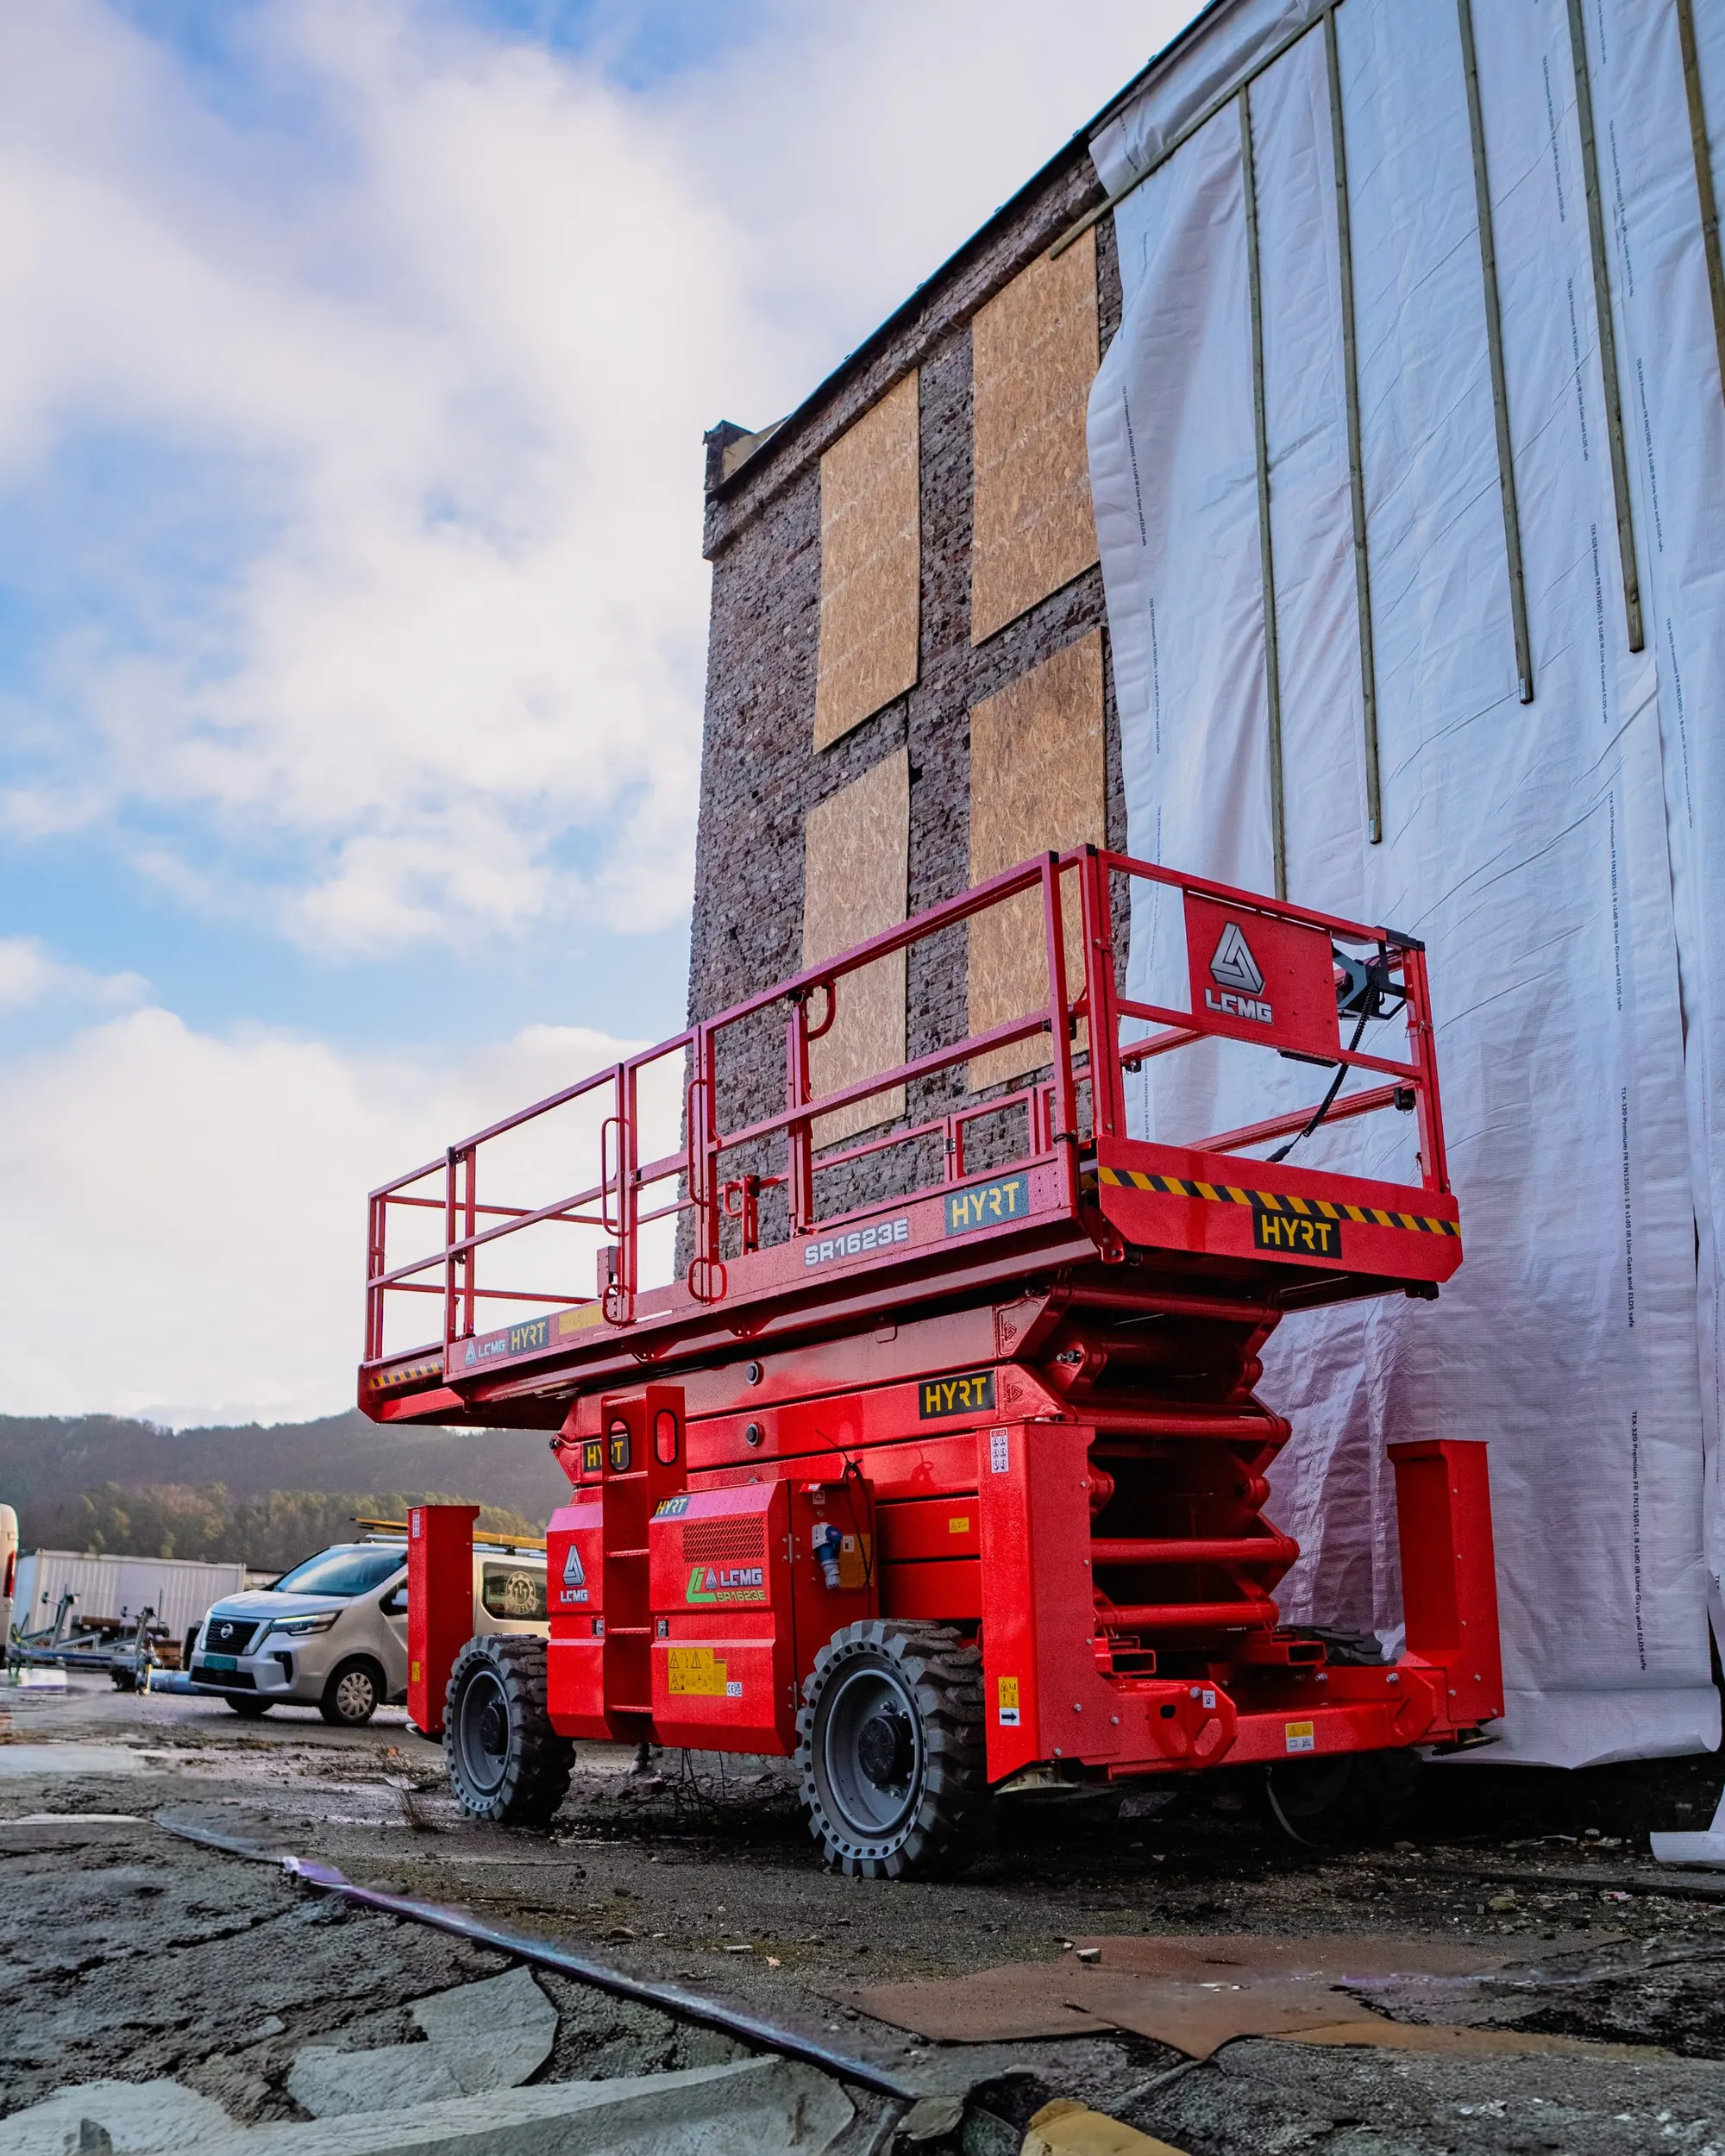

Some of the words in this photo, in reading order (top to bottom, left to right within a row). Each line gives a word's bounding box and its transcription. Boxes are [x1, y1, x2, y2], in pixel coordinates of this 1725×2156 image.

[1571, 326, 1577, 335] FR
[1643, 410, 1648, 418] FR
[1595, 577, 1601, 587] FR
[1670, 643, 1678, 674] Premium
[1674, 674, 1680, 684] FR
[1610, 849, 1616, 859] FR
[1613, 920, 1619, 929] IR
[952, 1181, 1019, 1228] HYRT
[1622, 1151, 1629, 1161] FR
[1626, 1230, 1632, 1238] IR
[804, 1218, 909, 1266] SR1623E
[1261, 1214, 1332, 1251] HYRT
[511, 1321, 547, 1351] HYRT
[925, 1376, 987, 1413] HYRT
[1632, 1481, 1639, 1491] FR
[656, 1498, 688, 1515] HYRT
[1634, 1565, 1640, 1574] IR
[716, 1589, 767, 1602] SR1623E
[1636, 1632, 1645, 1652] ELDS
